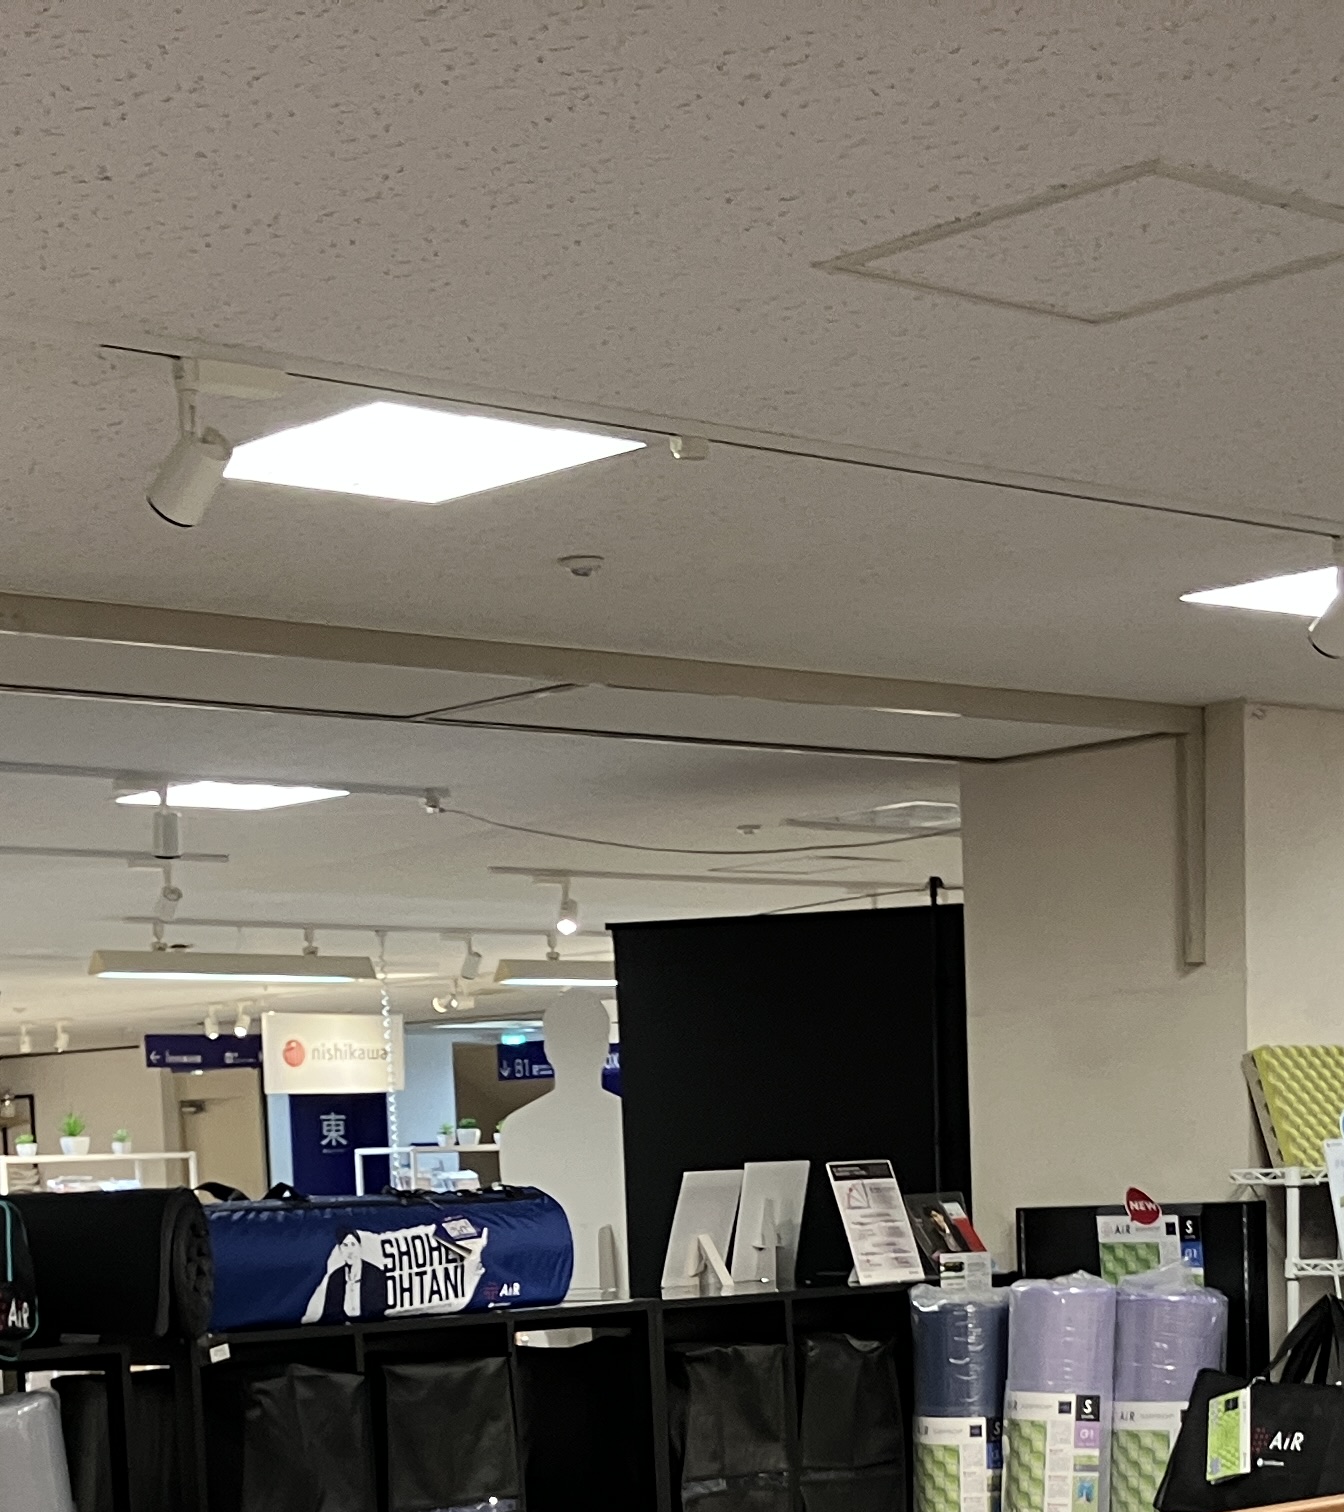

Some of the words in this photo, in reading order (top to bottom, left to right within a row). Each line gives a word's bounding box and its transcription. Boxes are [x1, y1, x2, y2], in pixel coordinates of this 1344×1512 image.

[312, 1042, 389, 1061] nishikawa
[320, 1112, 348, 1146] 東
[1129, 1200, 1158, 1212] NEW
[1185, 1219, 1194, 1234] S
[381, 1234, 467, 1272] SHOHE
[385, 1264, 466, 1310] OHTANI
[1082, 1399, 1093, 1414] S
